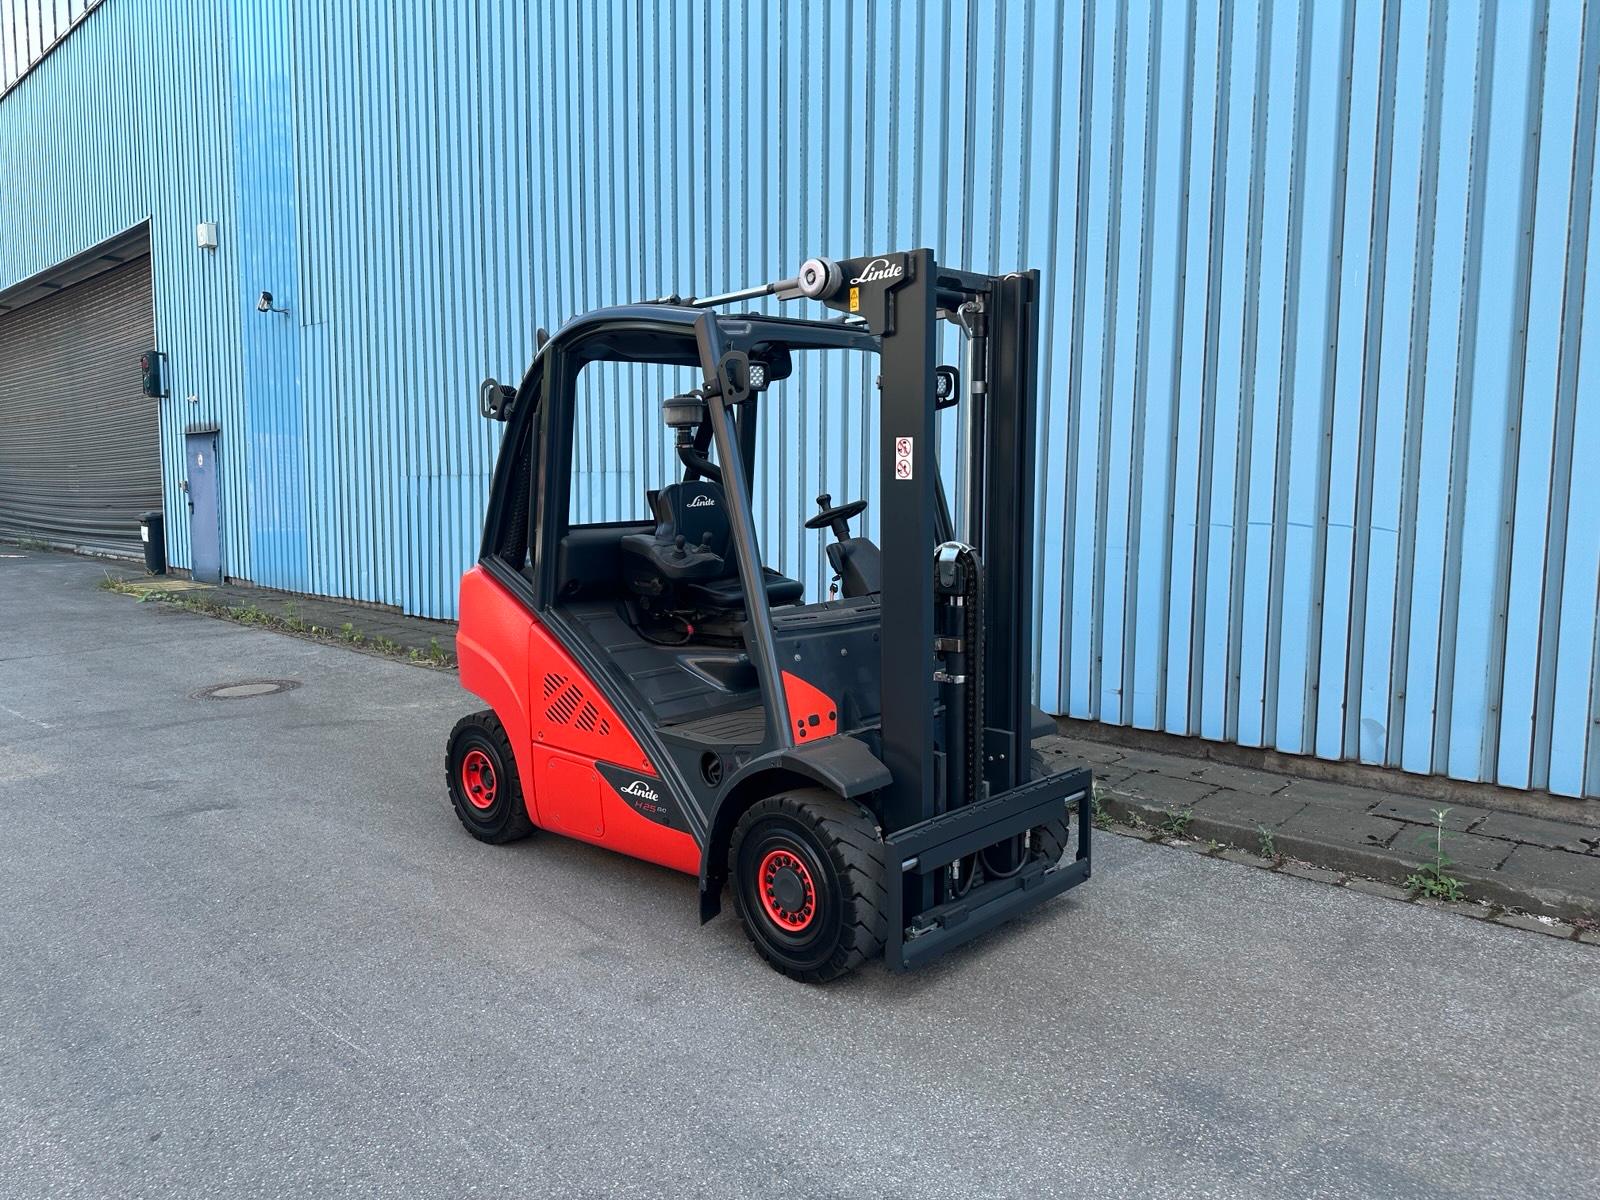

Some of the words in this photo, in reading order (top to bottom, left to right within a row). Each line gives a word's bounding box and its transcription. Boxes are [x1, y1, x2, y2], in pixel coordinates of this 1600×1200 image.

[850, 258, 902, 285] Linde
[686, 494, 715, 508] Linde
[620, 780, 659, 802] Linde
